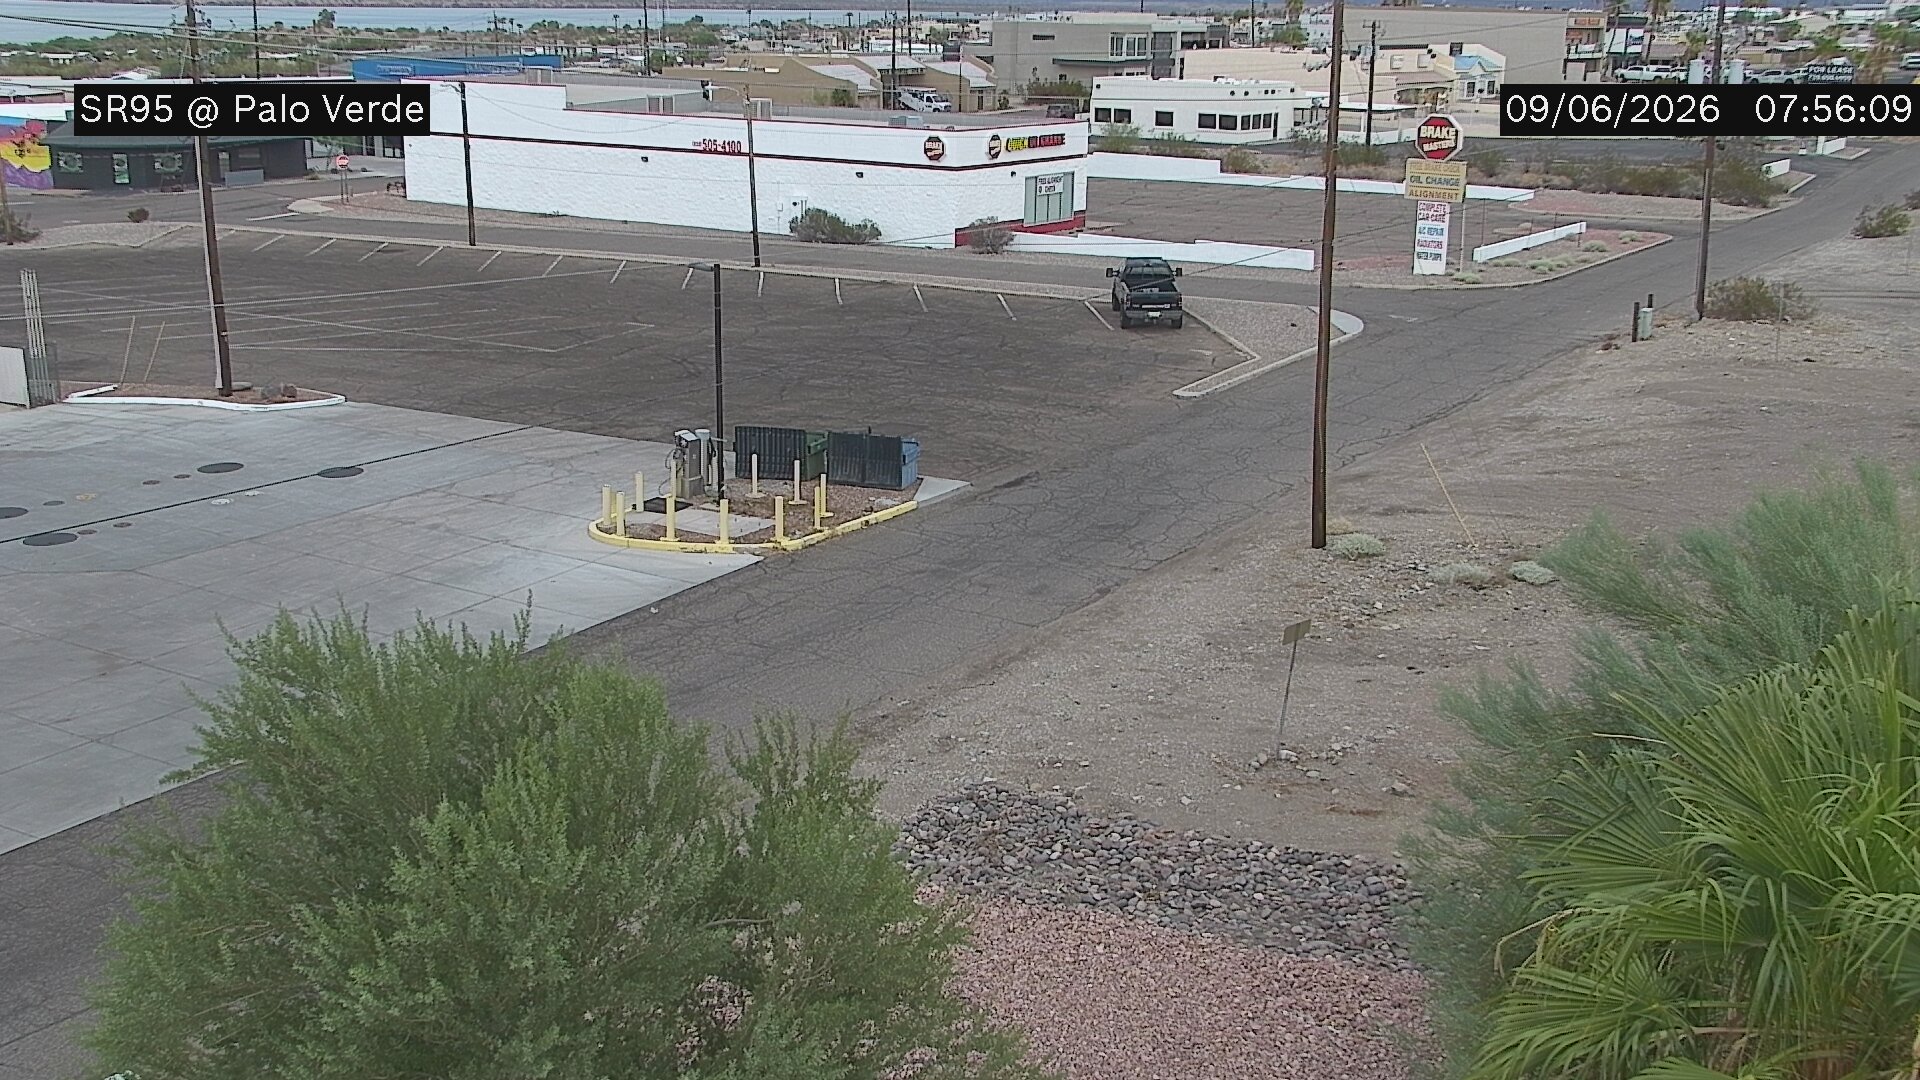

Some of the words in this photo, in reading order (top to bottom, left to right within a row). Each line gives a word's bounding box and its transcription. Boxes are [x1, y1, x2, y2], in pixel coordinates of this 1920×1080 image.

[1826, 66, 1853, 74] LEASE
[1420, 125, 1456, 139] BRAKE
[702, 138, 742, 153] 505-4100
[1410, 175, 1423, 184] OIL
[1426, 176, 1460, 187] CHANGE
[1408, 189, 1459, 200] ALIGNMENT
